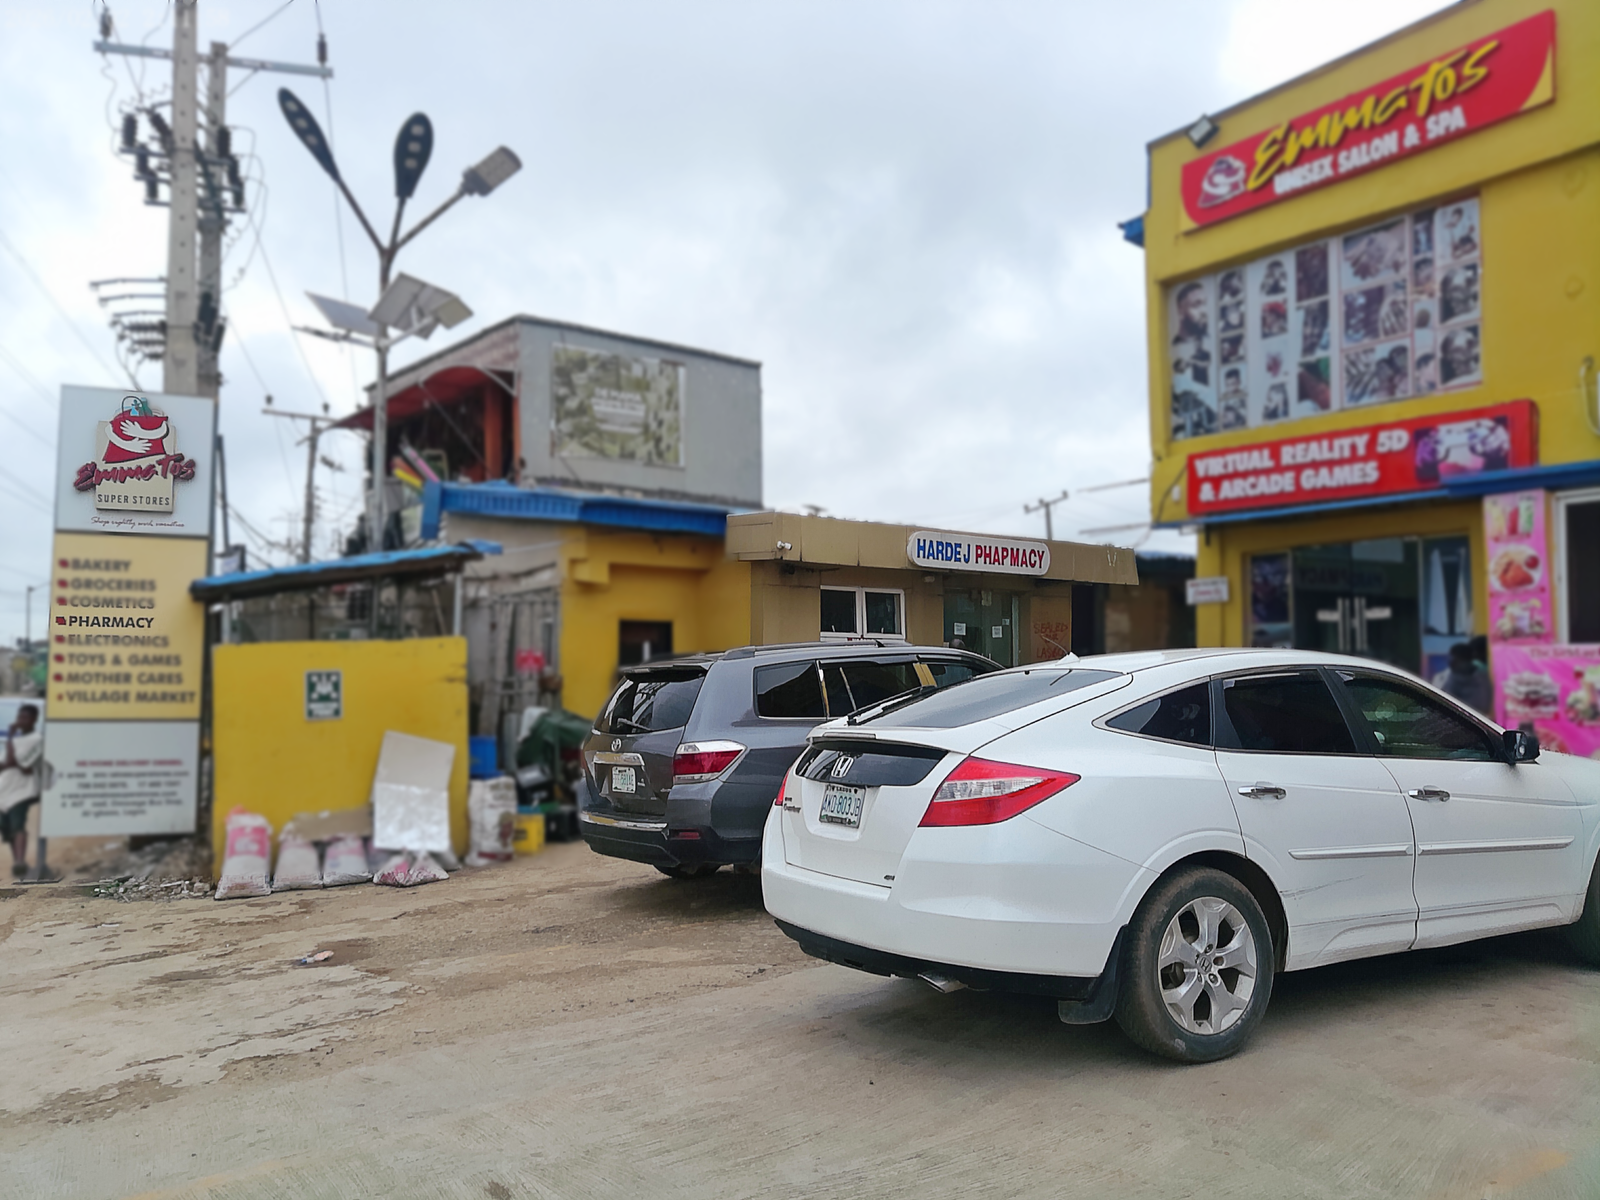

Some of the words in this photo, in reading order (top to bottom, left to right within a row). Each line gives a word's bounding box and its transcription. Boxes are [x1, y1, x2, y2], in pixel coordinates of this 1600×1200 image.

[1274, 157, 1333, 194] UNISEX
[1338, 132, 1398, 174] SALON
[1404, 123, 1421, 149] &
[1427, 106, 1466, 140] SPA
[1195, 449, 1274, 478] VIRTUAL
[1281, 435, 1370, 466] REALITY
[1377, 428, 1410, 454] 5D
[1199, 483, 1216, 503] &
[1219, 473, 1295, 499] ARCADE
[1300, 461, 1379, 489] GAMES
[97, 493, 129, 504] SUPER
[132, 495, 170, 506] STORES
[916, 538, 971, 564] HARDEJ
[71, 559, 131, 572] BAKERY
[70, 578, 156, 592] GROCERIES
[69, 595, 156, 609] COSMETICS
[68, 615, 155, 628] PHARMACY
[67, 634, 170, 648] ELECTRONICS
[67, 653, 106, 666] TOYS
[111, 654, 122, 666] &
[128, 654, 182, 667] GAMES
[65, 672, 132, 685] MOTHER
[137, 672, 183, 686] CARES
[66, 691, 130, 703] VILLAGE
[135, 690, 196, 704] MARKET
